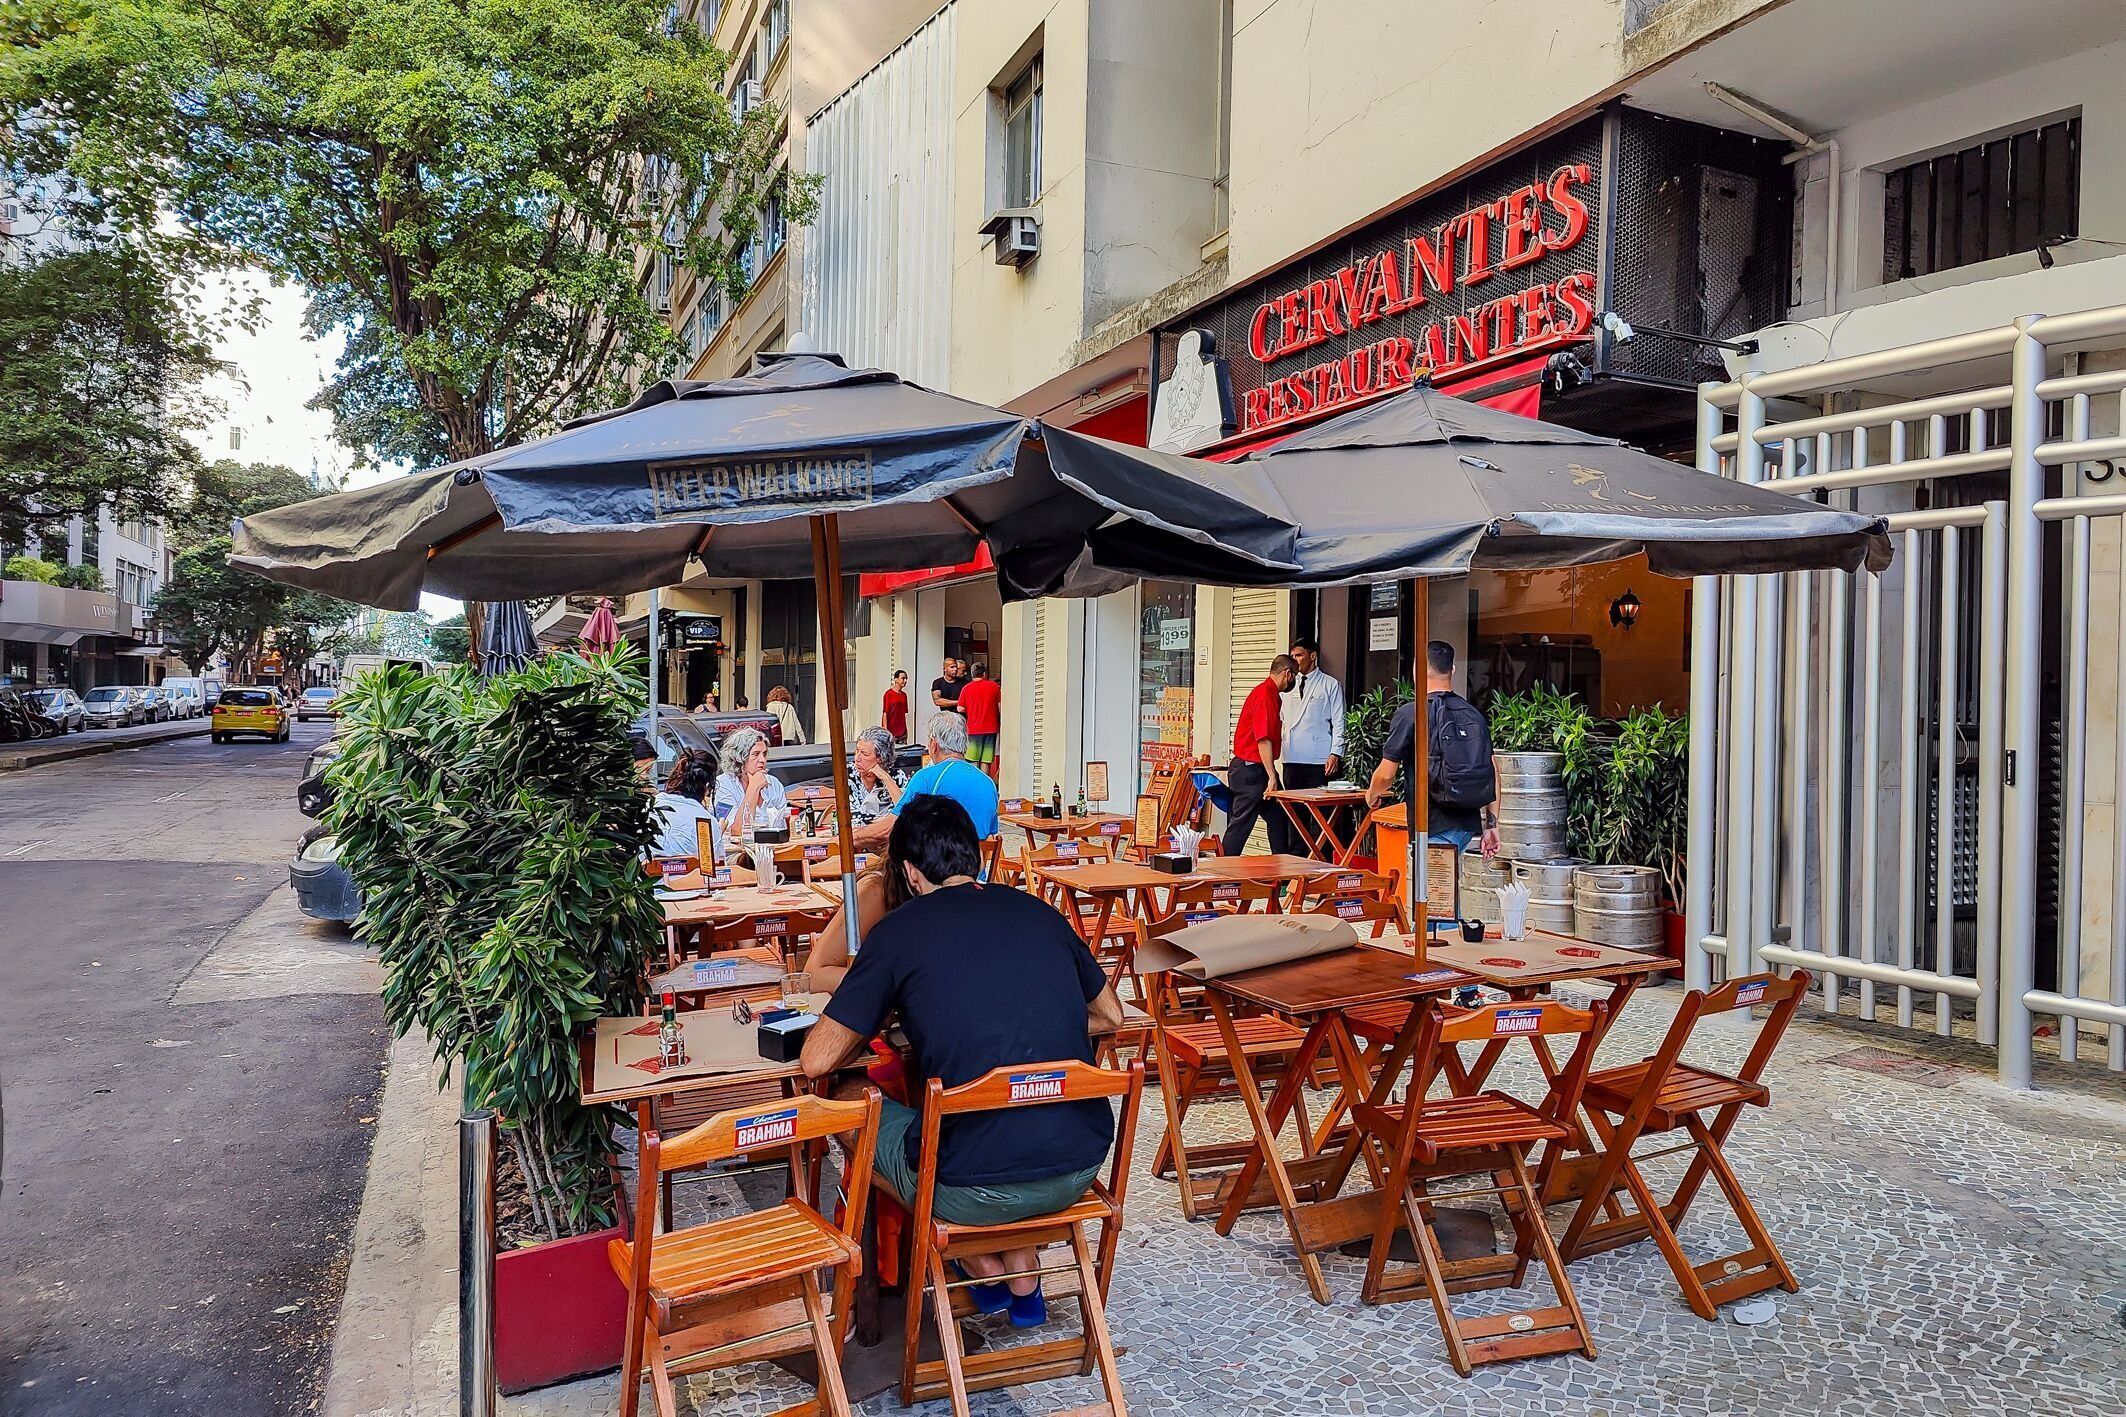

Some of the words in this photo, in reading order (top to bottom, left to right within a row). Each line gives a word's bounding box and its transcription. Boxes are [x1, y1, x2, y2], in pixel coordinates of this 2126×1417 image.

[1247, 163, 1592, 363] CERVANTES
[1242, 269, 1598, 433] RESTAURANTES
[659, 465, 730, 508] KEEP
[734, 458, 862, 501] WALKING
[1540, 501, 1651, 513] JOHNNIE
[1655, 503, 1757, 514] WALKER
[1161, 630, 1189, 646] 19,99
[662, 864, 687, 872] BRAHMA
[1212, 887, 1239, 898] BRAHMA
[1337, 905, 1364, 918] BRAHMA
[755, 922, 786, 935] BRAHMA
[696, 968, 736, 984] BRAHMA
[1496, 1016, 1538, 1032] BRAHMA
[1011, 1080, 1062, 1100] BRAHMA
[737, 1119, 793, 1147] BRAHMA
